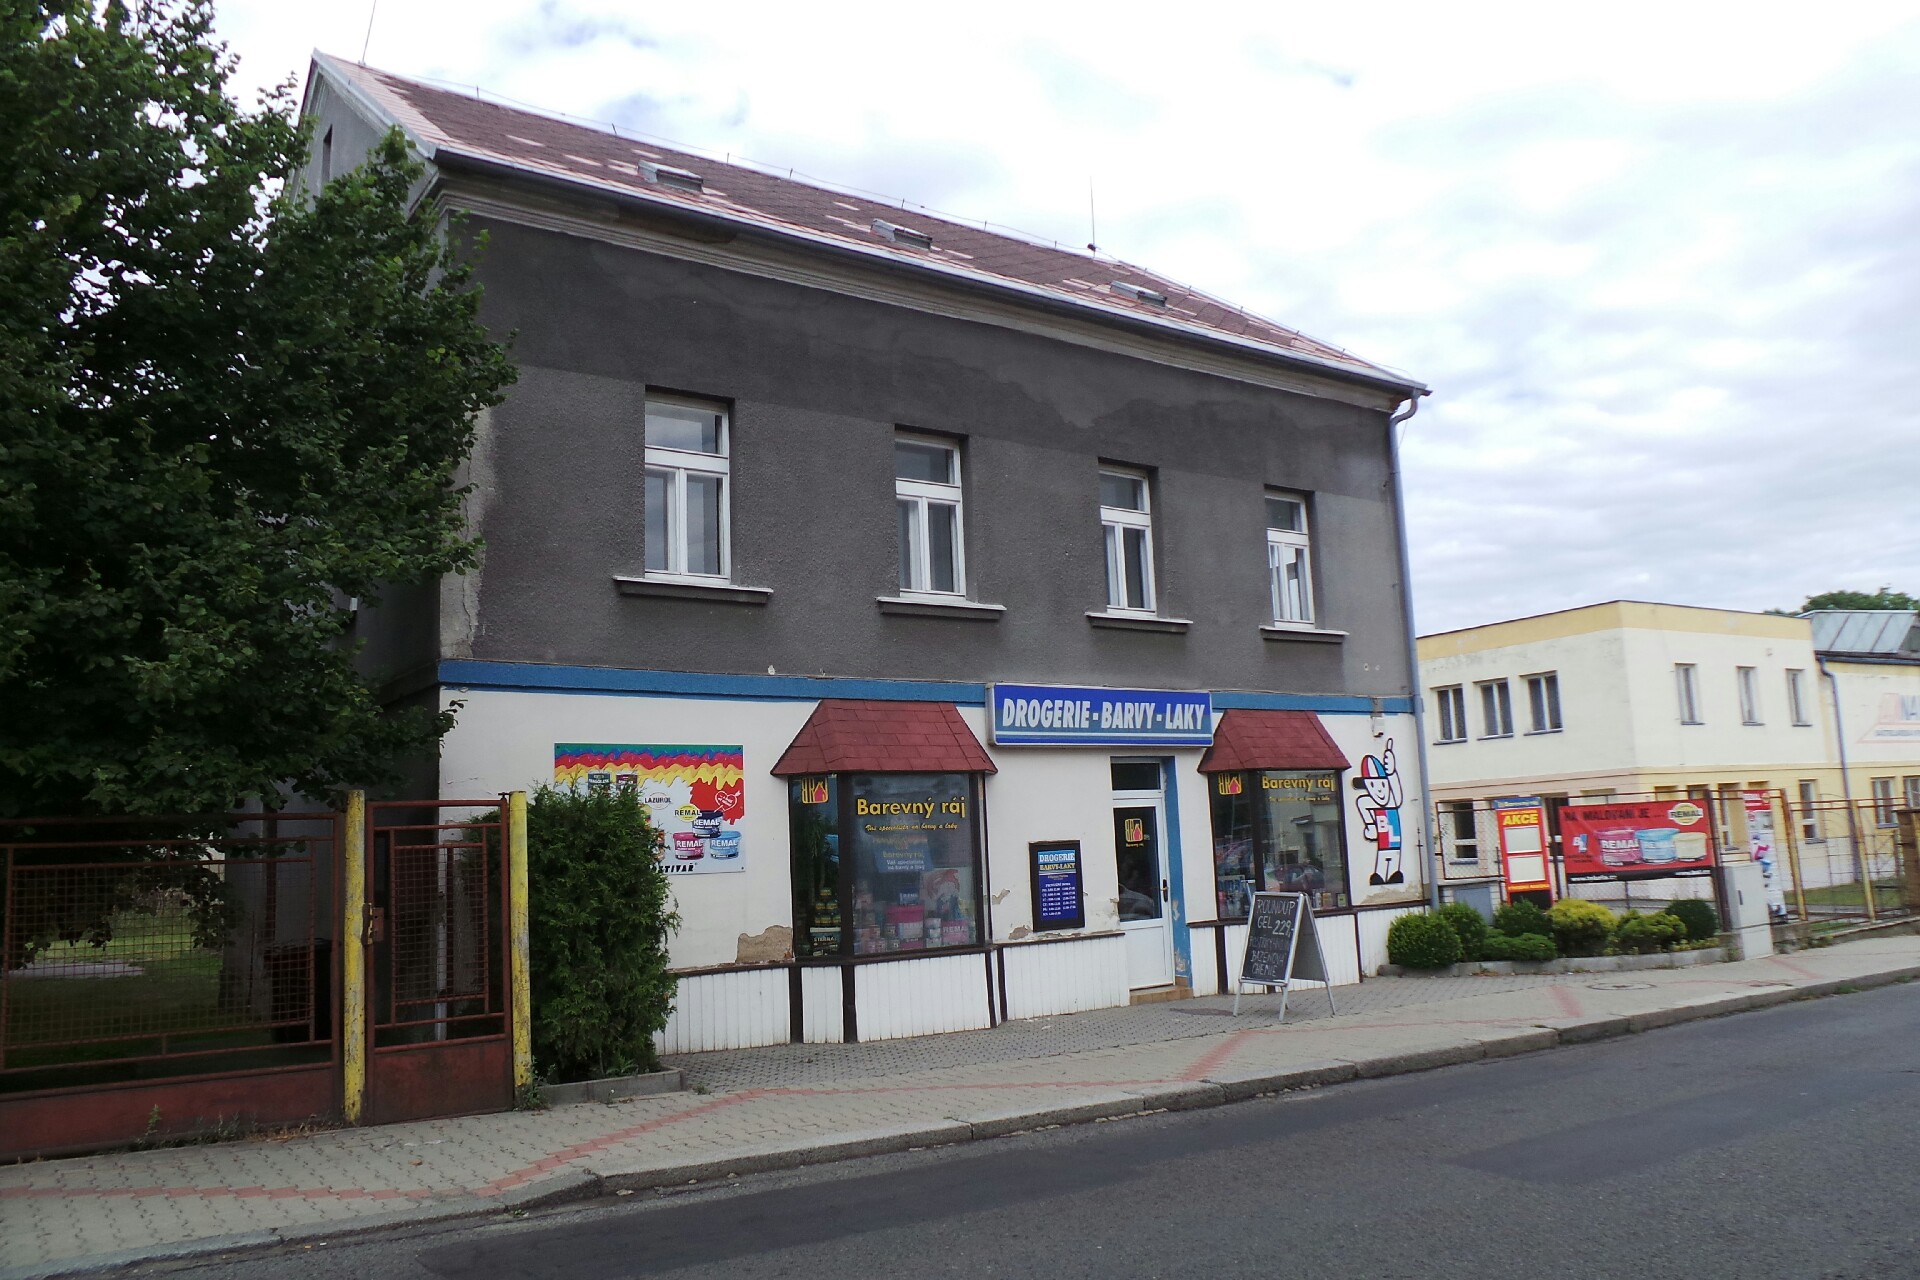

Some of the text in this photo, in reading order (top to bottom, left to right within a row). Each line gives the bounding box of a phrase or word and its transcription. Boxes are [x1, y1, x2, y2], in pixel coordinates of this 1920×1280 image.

[1002, 698, 1206, 730] DROGERIE BARVY LAKY
[857, 796, 966, 819] Barevný ráj
[1503, 813, 1539, 826] AKCE
[676, 840, 703, 848] REMAL
[1040, 853, 1075, 862] DROGERIE
[657, 862, 695, 873] STIVAŘ
[1257, 915, 1273, 929] GEL
